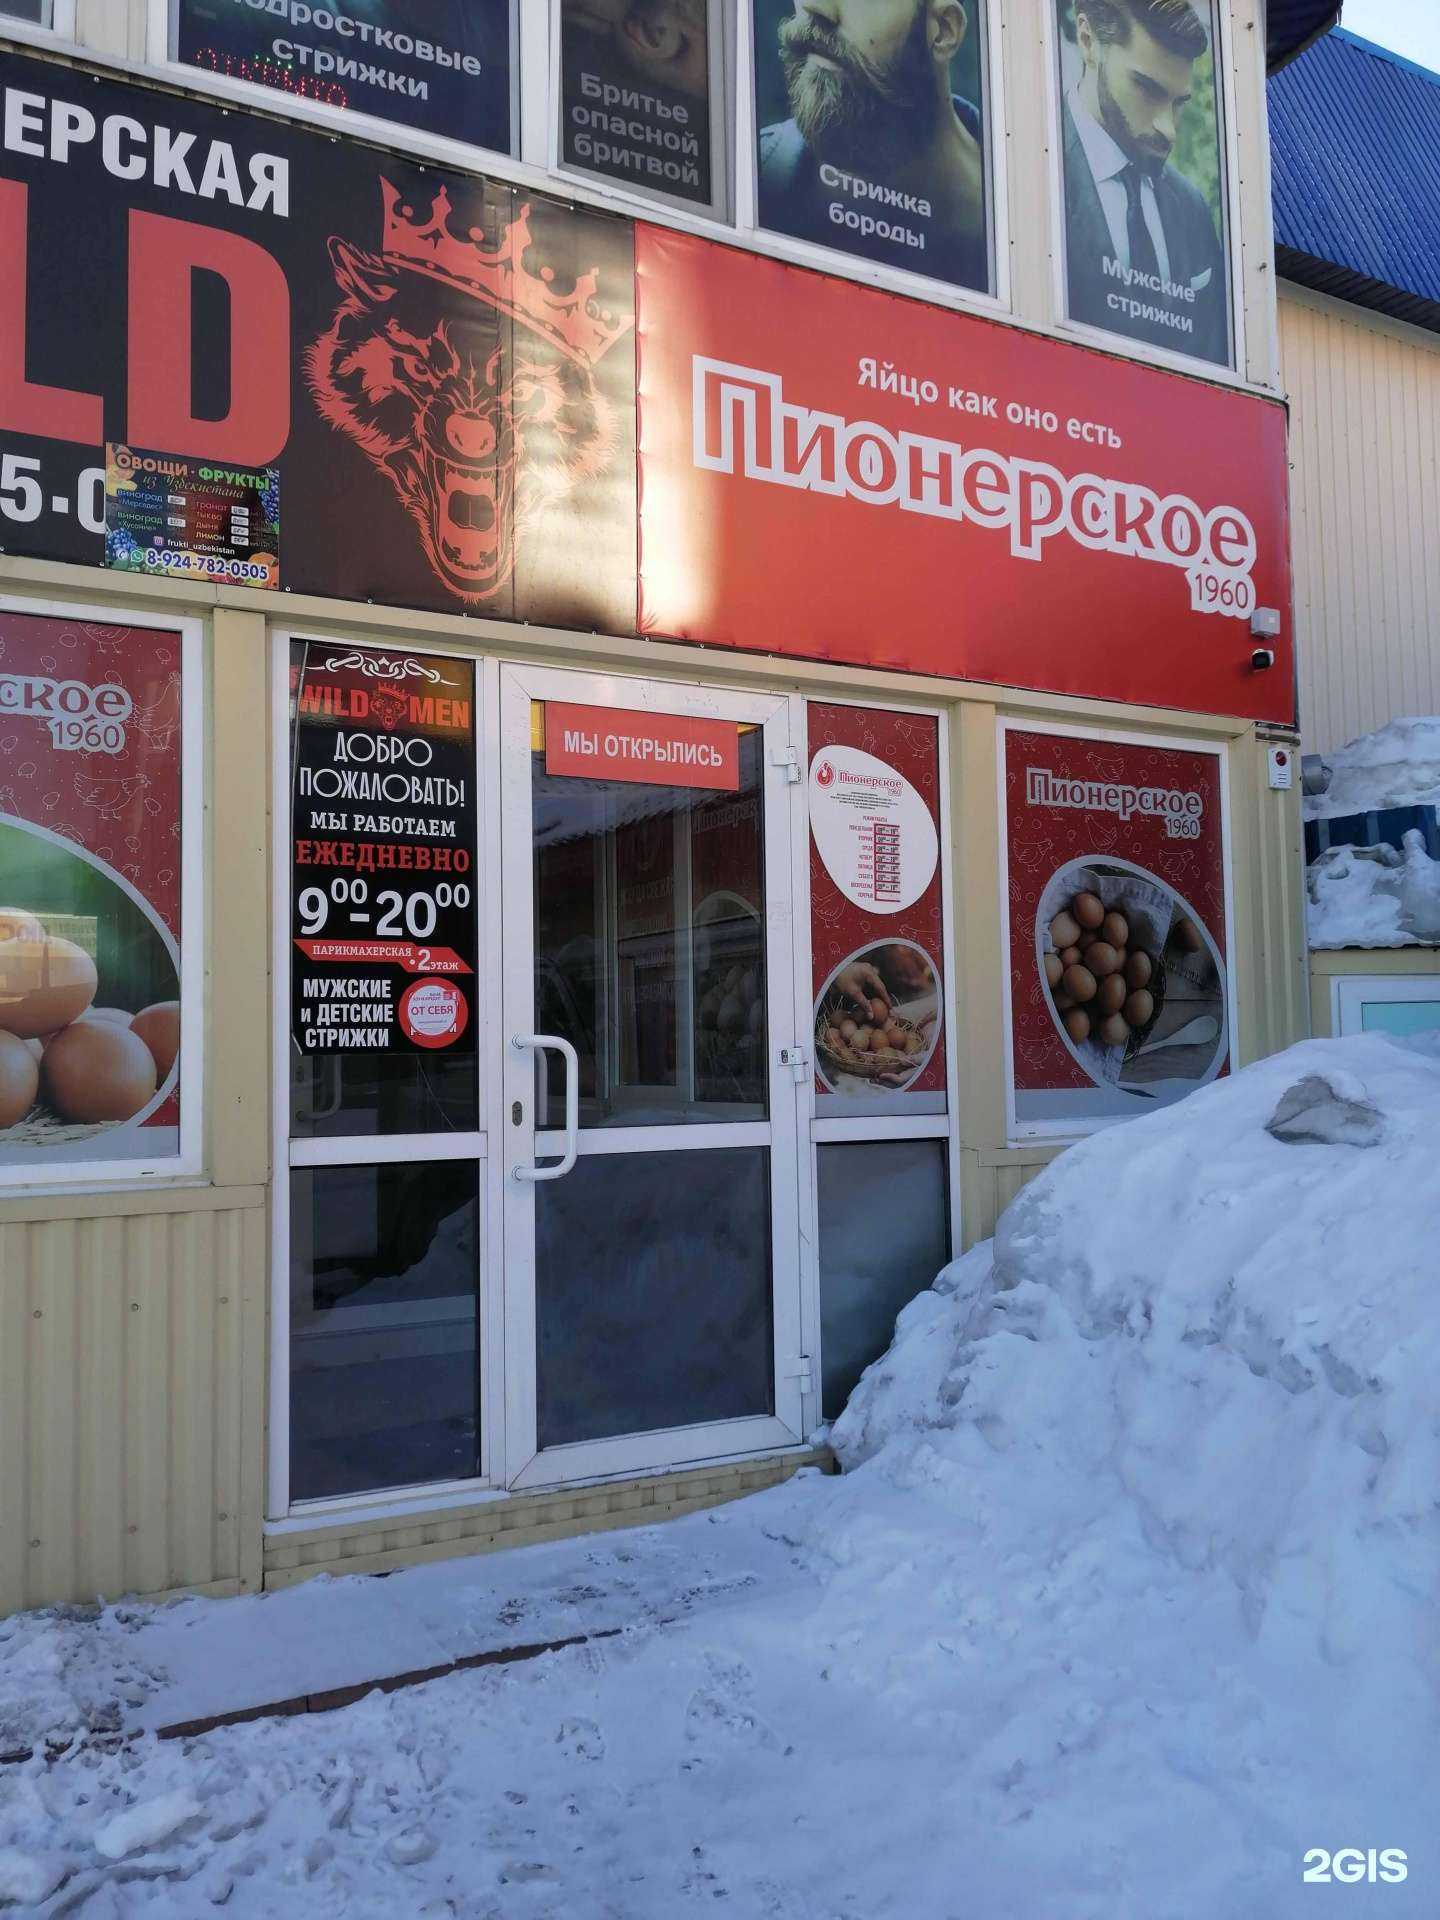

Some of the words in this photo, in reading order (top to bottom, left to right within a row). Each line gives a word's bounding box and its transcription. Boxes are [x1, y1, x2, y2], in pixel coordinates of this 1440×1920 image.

[233, 0, 481, 75] одростковые
[272, 39, 428, 100] стрижки
[581, 72, 688, 124] Бритье
[572, 106, 698, 157] опасной
[4, 87, 290, 218] ЕРСКАЯ
[574, 133, 698, 186] бритвой
[820, 164, 931, 217] Стрижка
[829, 203, 924, 249] бороды
[1103, 256, 1196, 302] Мужские
[1107, 294, 1192, 333] стрижки
[858, 357, 938, 405] Яйцо
[949, 386, 998, 418] как
[1006, 402, 1058, 432] оно
[1066, 418, 1121, 448] есть
[116, 452, 188, 477] ОВОЩИ
[198, 467, 270, 490] ФРУКТЫ
[694, 356, 1256, 566] Пионерское
[117, 490, 163, 503] виноград
[117, 511, 163, 526] виноград
[147, 550, 269, 580] 8-924-782-0505
[167, 539, 236, 556] frukti_uzbekistan
[1195, 572, 1249, 609] 1960
[300, 685, 369, 718] WILD
[409, 697, 470, 729] MEN
[53, 719, 121, 749] 1960
[334, 731, 433, 767] ДОБРО
[564, 730, 598, 755] МЫ
[604, 734, 723, 767] ОТКРЫЛИСЬ
[300, 766, 465, 807] ПОЖАЛОВАТЬ!
[840, 770, 903, 788] Пионерское
[1027, 767, 1203, 820] Пионерское
[310, 811, 347, 831] МЫ
[353, 814, 457, 837] РАБОТАЕМ
[1167, 818, 1199, 837] 1960
[296, 840, 470, 872] ЕЖЕДНЕВНО
[312, 945, 412, 957] ПАРИКМАХЕРСКАЯ
[430, 960, 459, 971] этаж
[303, 978, 391, 998] МУЖСКИЕ
[301, 1007, 311, 1023] и
[317, 1004, 394, 1025] ДЕТСКИЕ
[411, 1006, 425, 1016] ОТ
[427, 1005, 454, 1015] СЕБЯ
[305, 1028, 389, 1047] СТРИЖКИ
